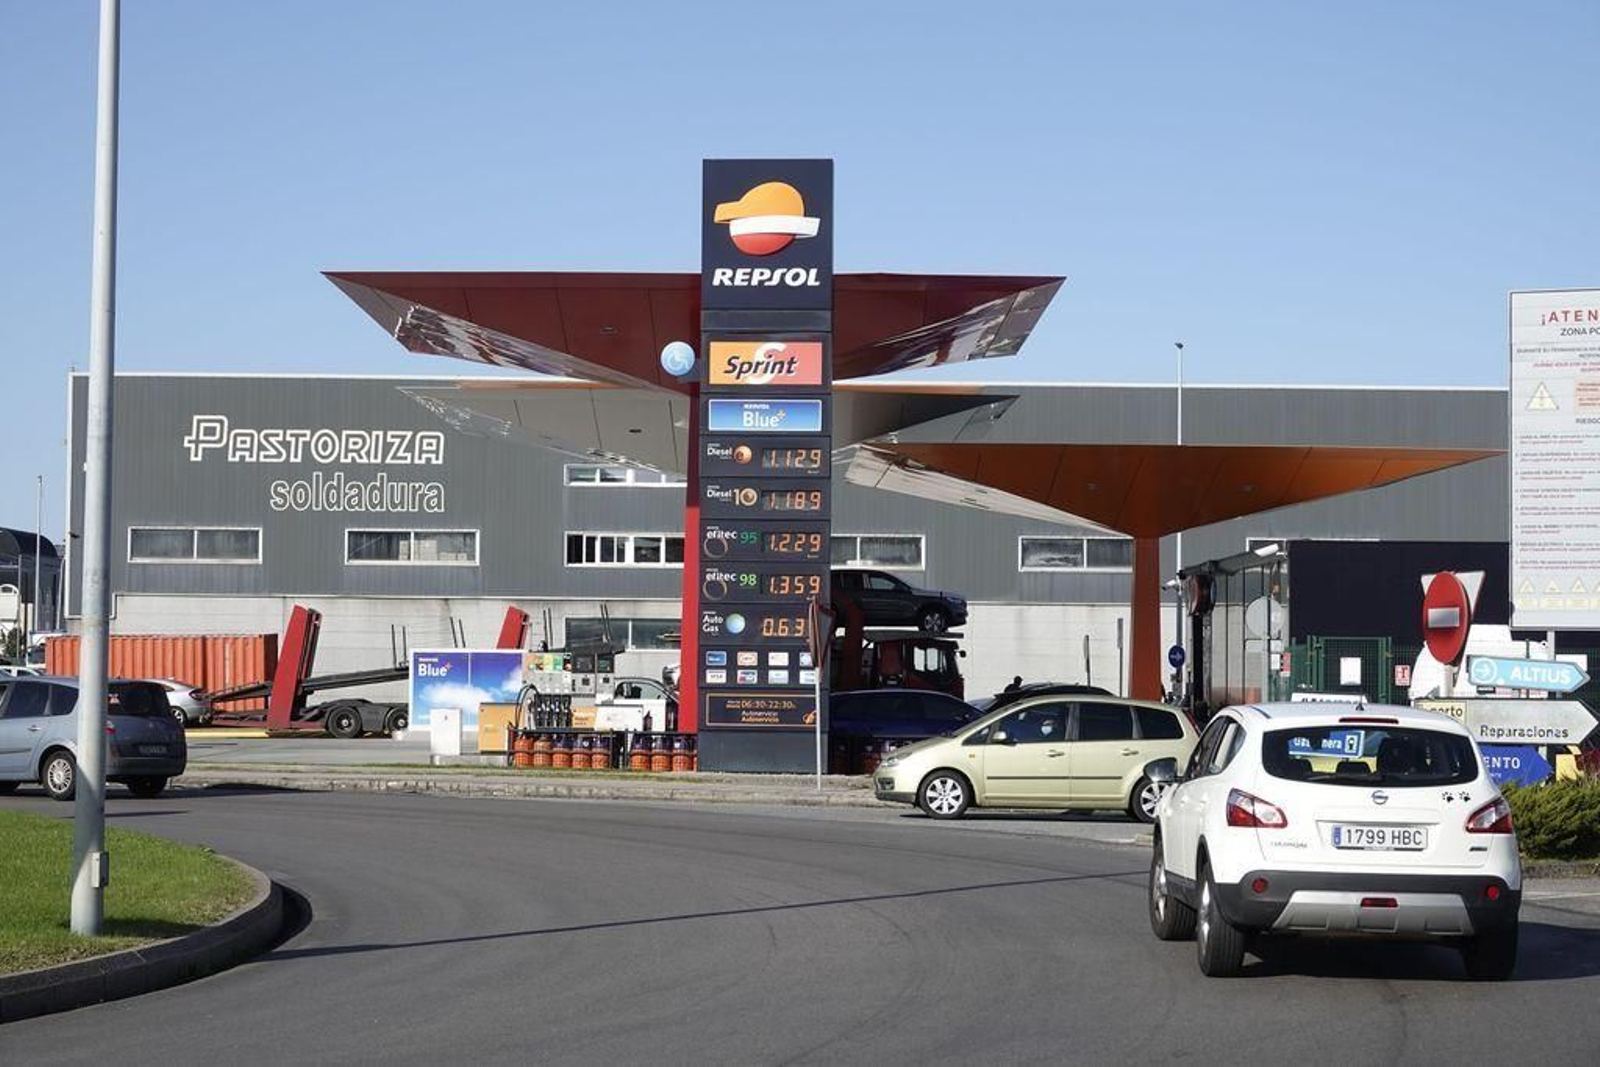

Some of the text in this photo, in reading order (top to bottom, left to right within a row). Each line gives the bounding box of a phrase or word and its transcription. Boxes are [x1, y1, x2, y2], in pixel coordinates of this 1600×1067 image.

[713, 267, 821, 287] REPSOL
[1560, 328, 1587, 337] ZONA
[724, 356, 797, 379] Sprint
[707, 447, 732, 456] Diesel
[270, 471, 445, 512] soldadura
[707, 489, 731, 498] Diesel
[740, 532, 757, 544] 95
[770, 533, 821, 552] 1.229
[739, 574, 757, 586] 98
[770, 575, 821, 594] 1.359
[702, 615, 723, 624] Auto
[763, 618, 806, 636] 0.63
[702, 624, 719, 632] Gas
[1510, 666, 1572, 685] ALTIUS
[1480, 724, 1569, 739] Reparaciones
[1483, 756, 1521, 769] ENTO
[1346, 828, 1423, 846] 1799 HBC
